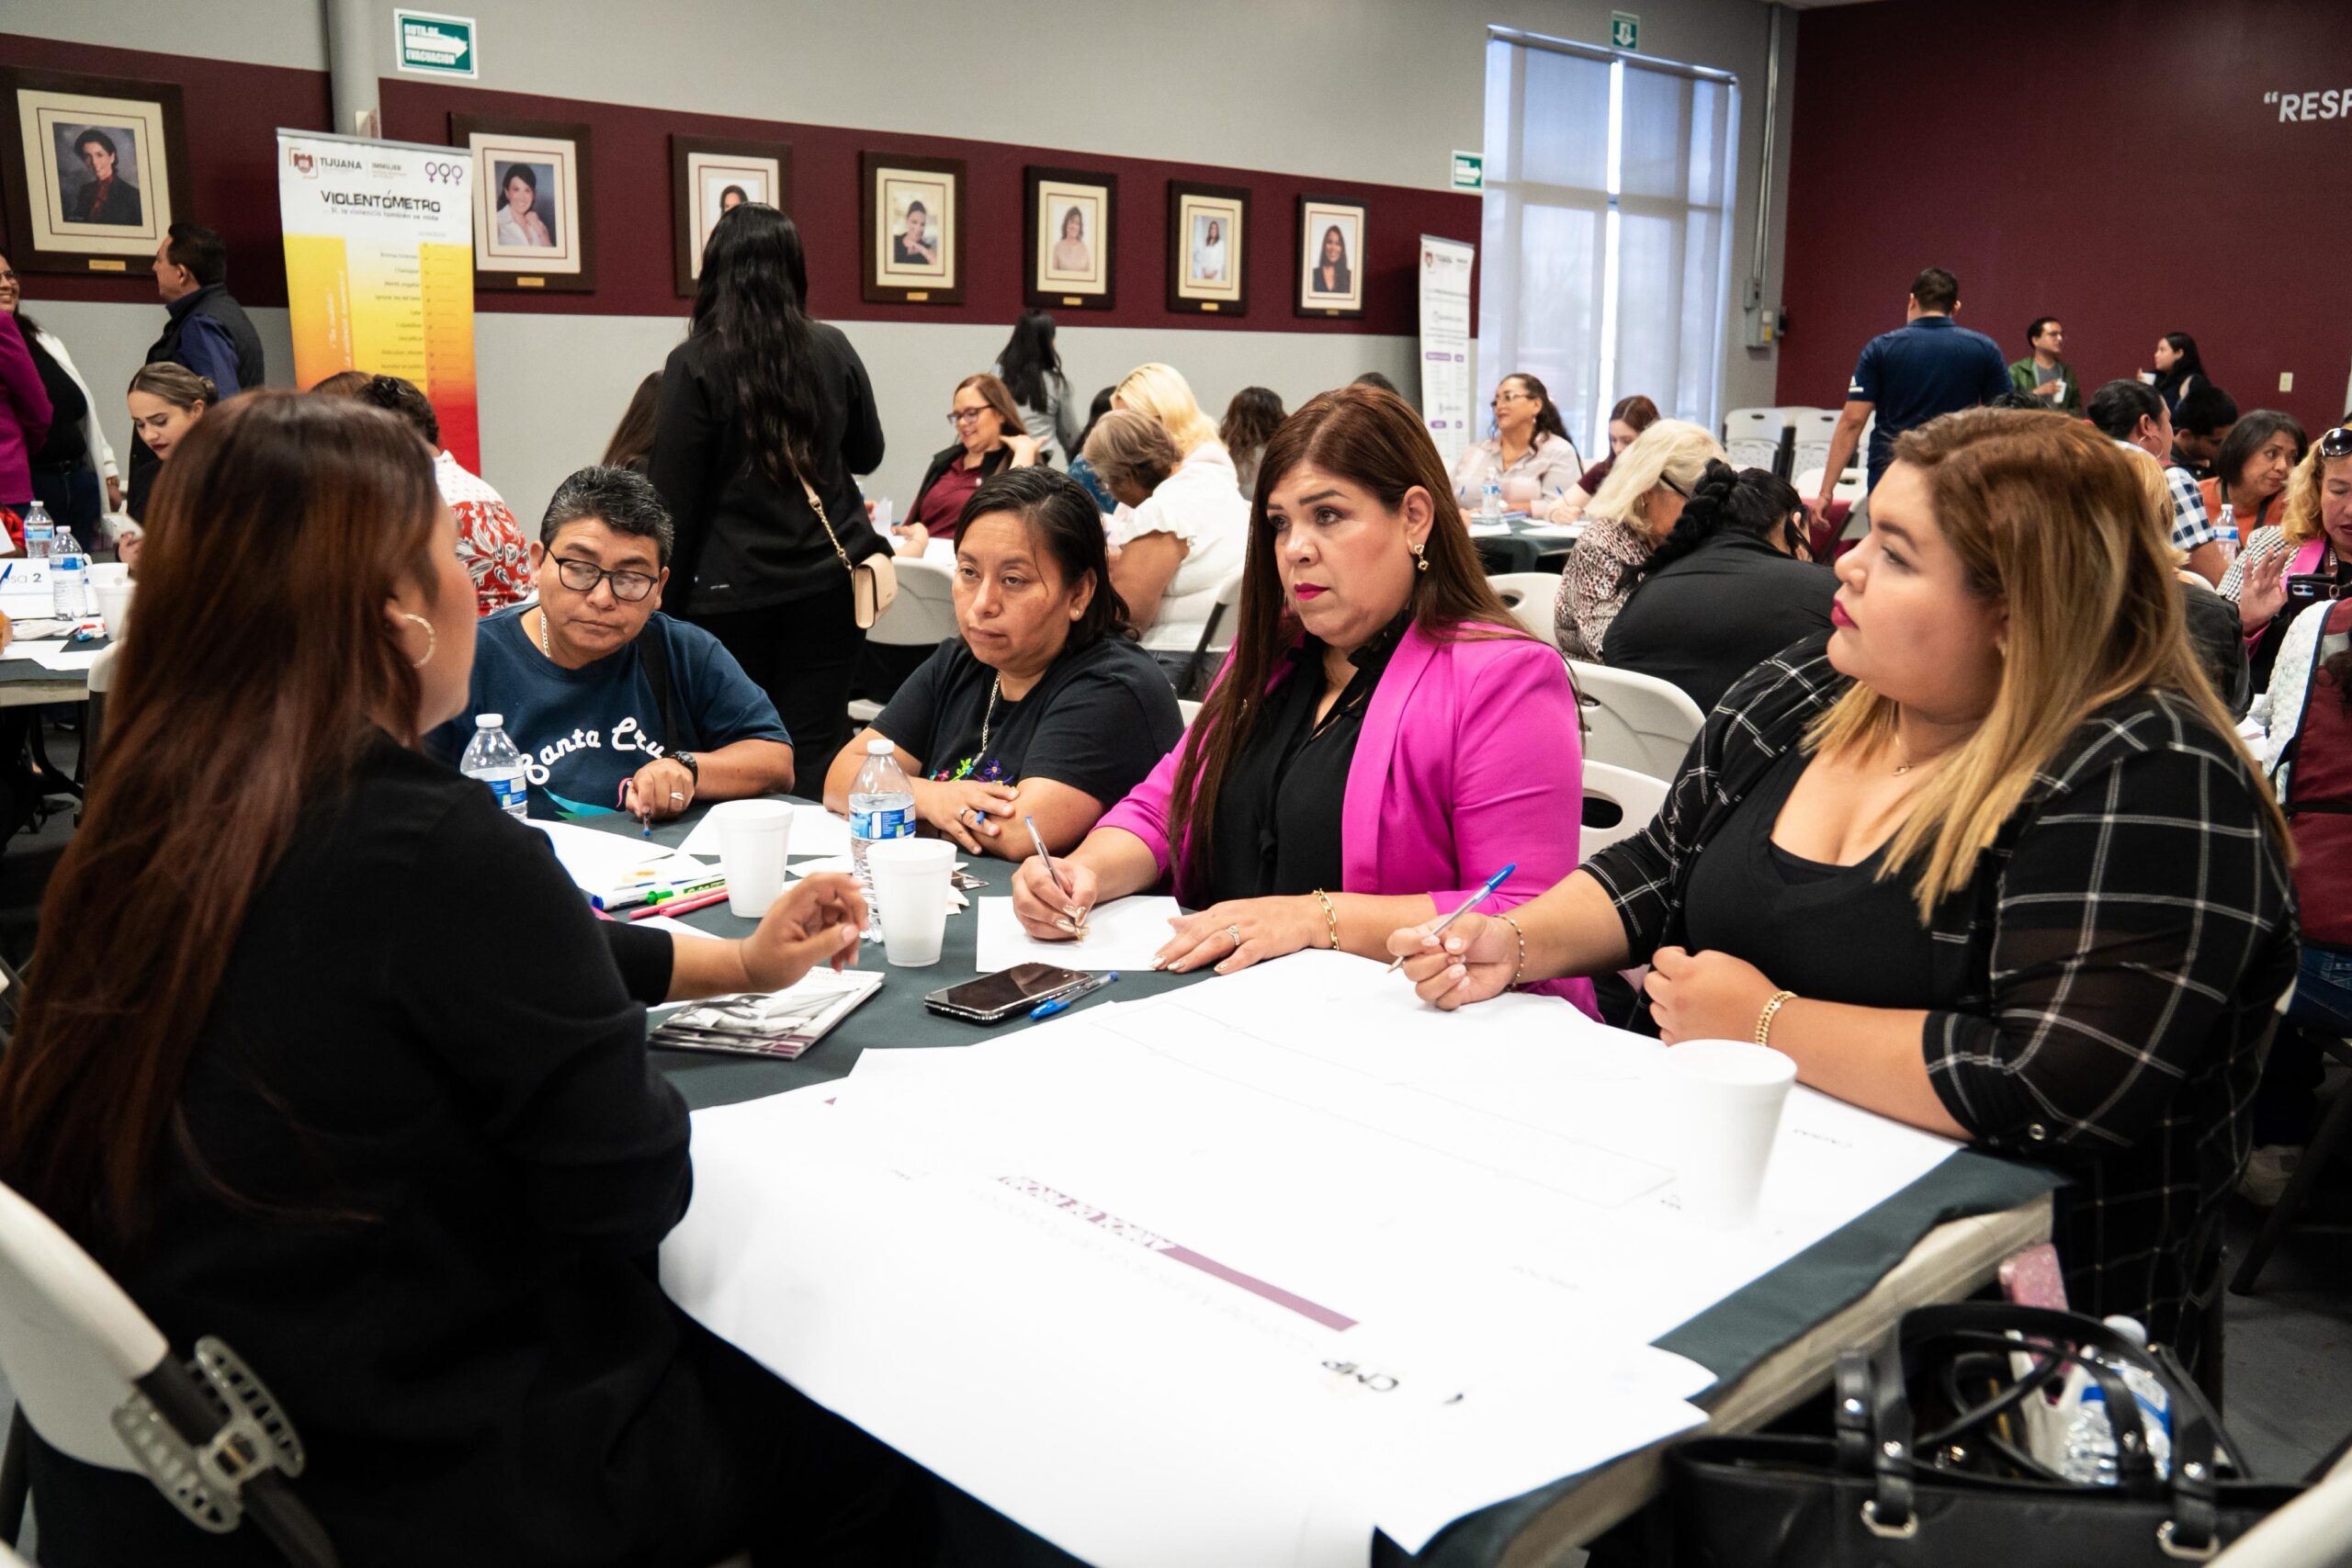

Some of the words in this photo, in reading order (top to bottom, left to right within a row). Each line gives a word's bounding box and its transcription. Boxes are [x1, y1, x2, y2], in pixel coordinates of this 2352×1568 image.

[320, 157, 362, 170] TIJUANA
[321, 189, 441, 213] VIOLENTÓMETRO
[33, 572, 41, 582] 2
[520, 728, 602, 785] Santa
[611, 716, 666, 760] Cru
